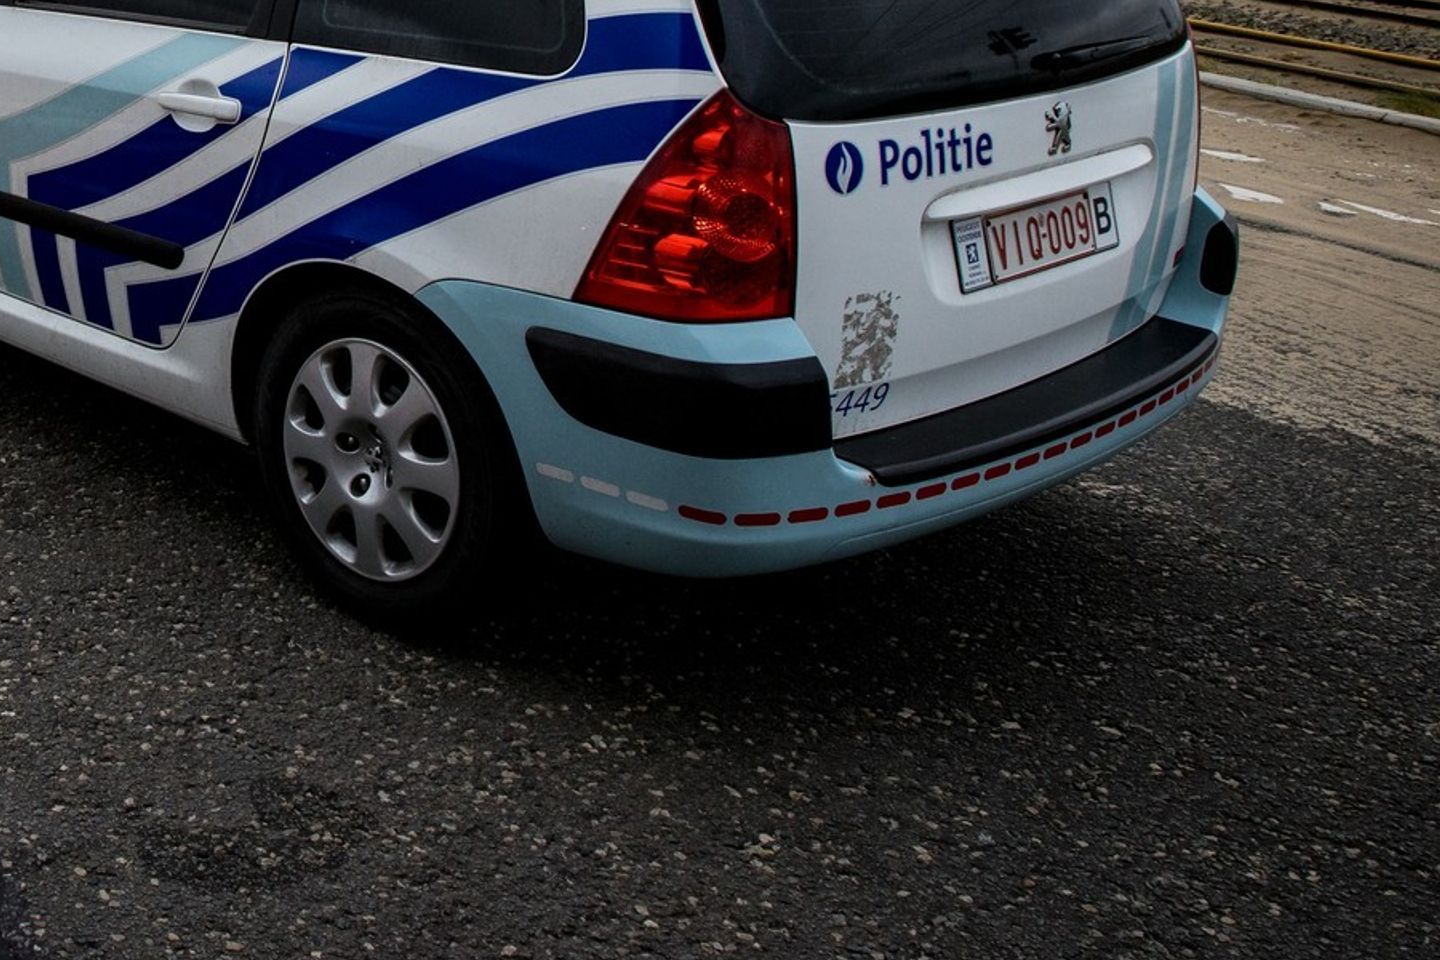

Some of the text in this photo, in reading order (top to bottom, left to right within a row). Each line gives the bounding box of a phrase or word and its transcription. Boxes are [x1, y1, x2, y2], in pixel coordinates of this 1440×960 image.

[878, 122, 993, 186] Politie
[991, 196, 1112, 271] VIQ-009 B
[830, 382, 890, 417] 449
